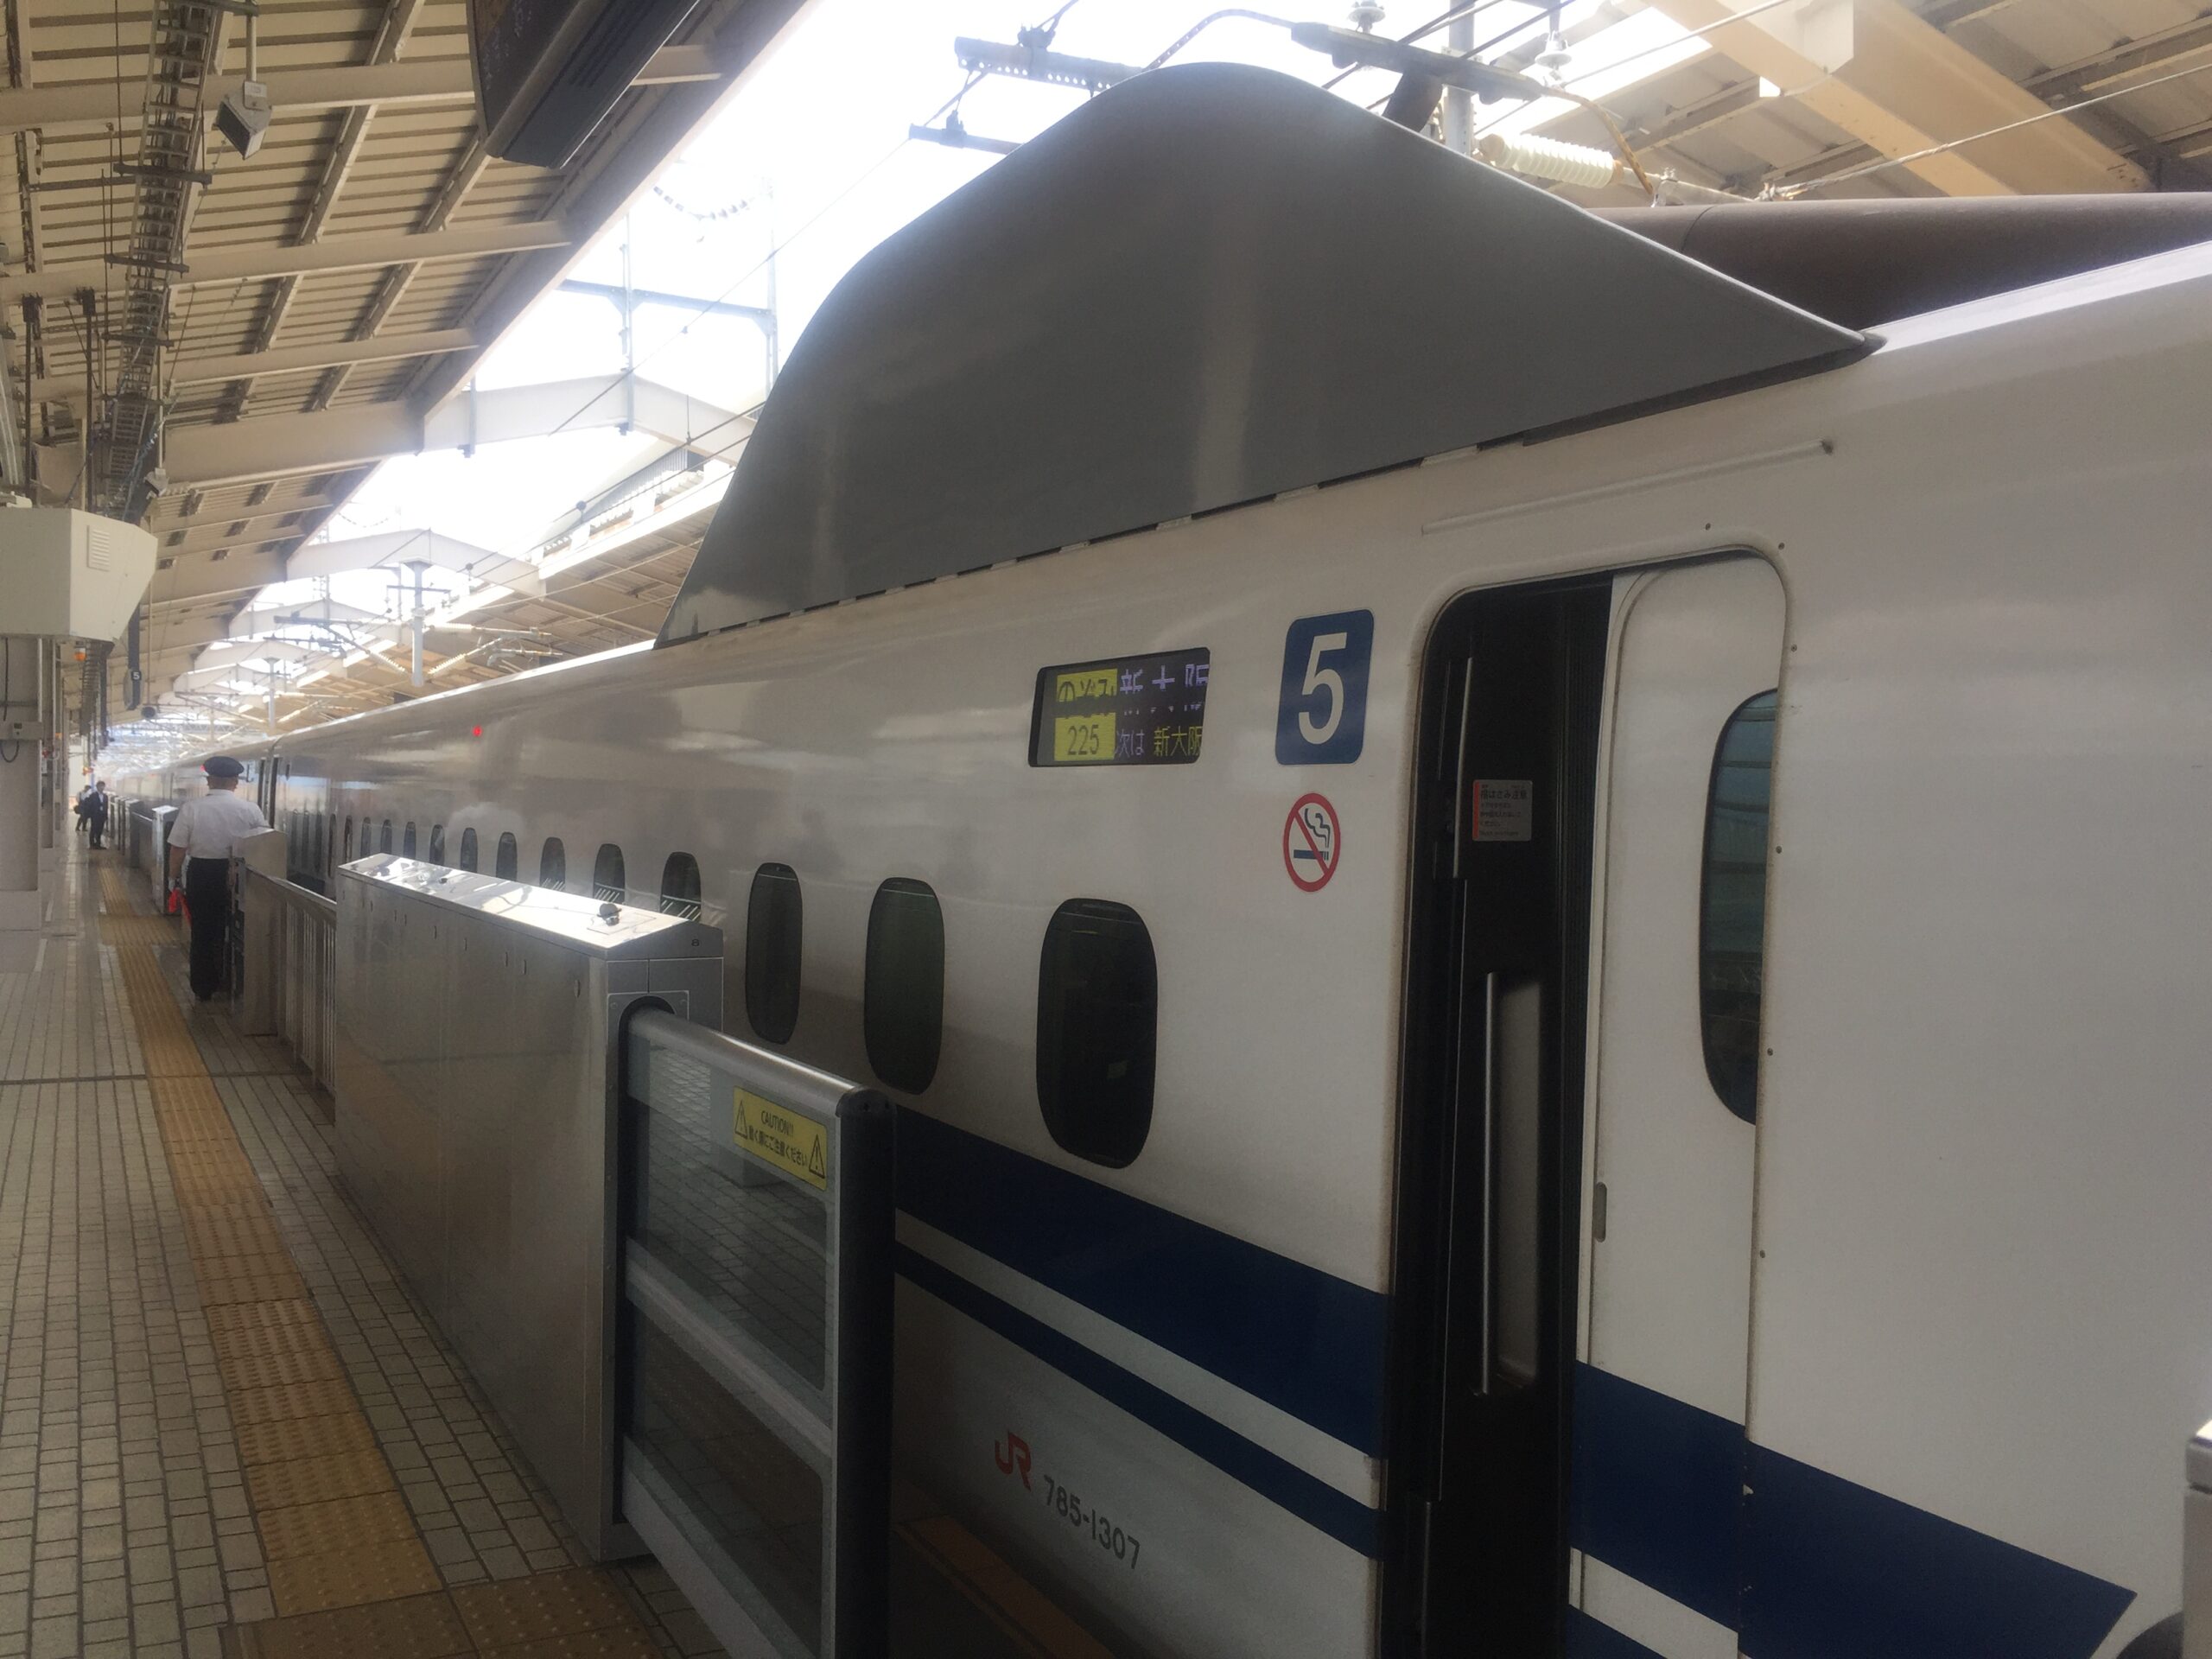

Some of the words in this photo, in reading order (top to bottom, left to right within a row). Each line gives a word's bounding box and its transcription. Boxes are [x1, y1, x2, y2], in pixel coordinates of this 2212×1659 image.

[1067, 723, 1099, 755] 225
[1299, 632, 1348, 746] 5
[995, 1431, 1032, 1491] JR
[1044, 1474, 1141, 1569] 785-1307
